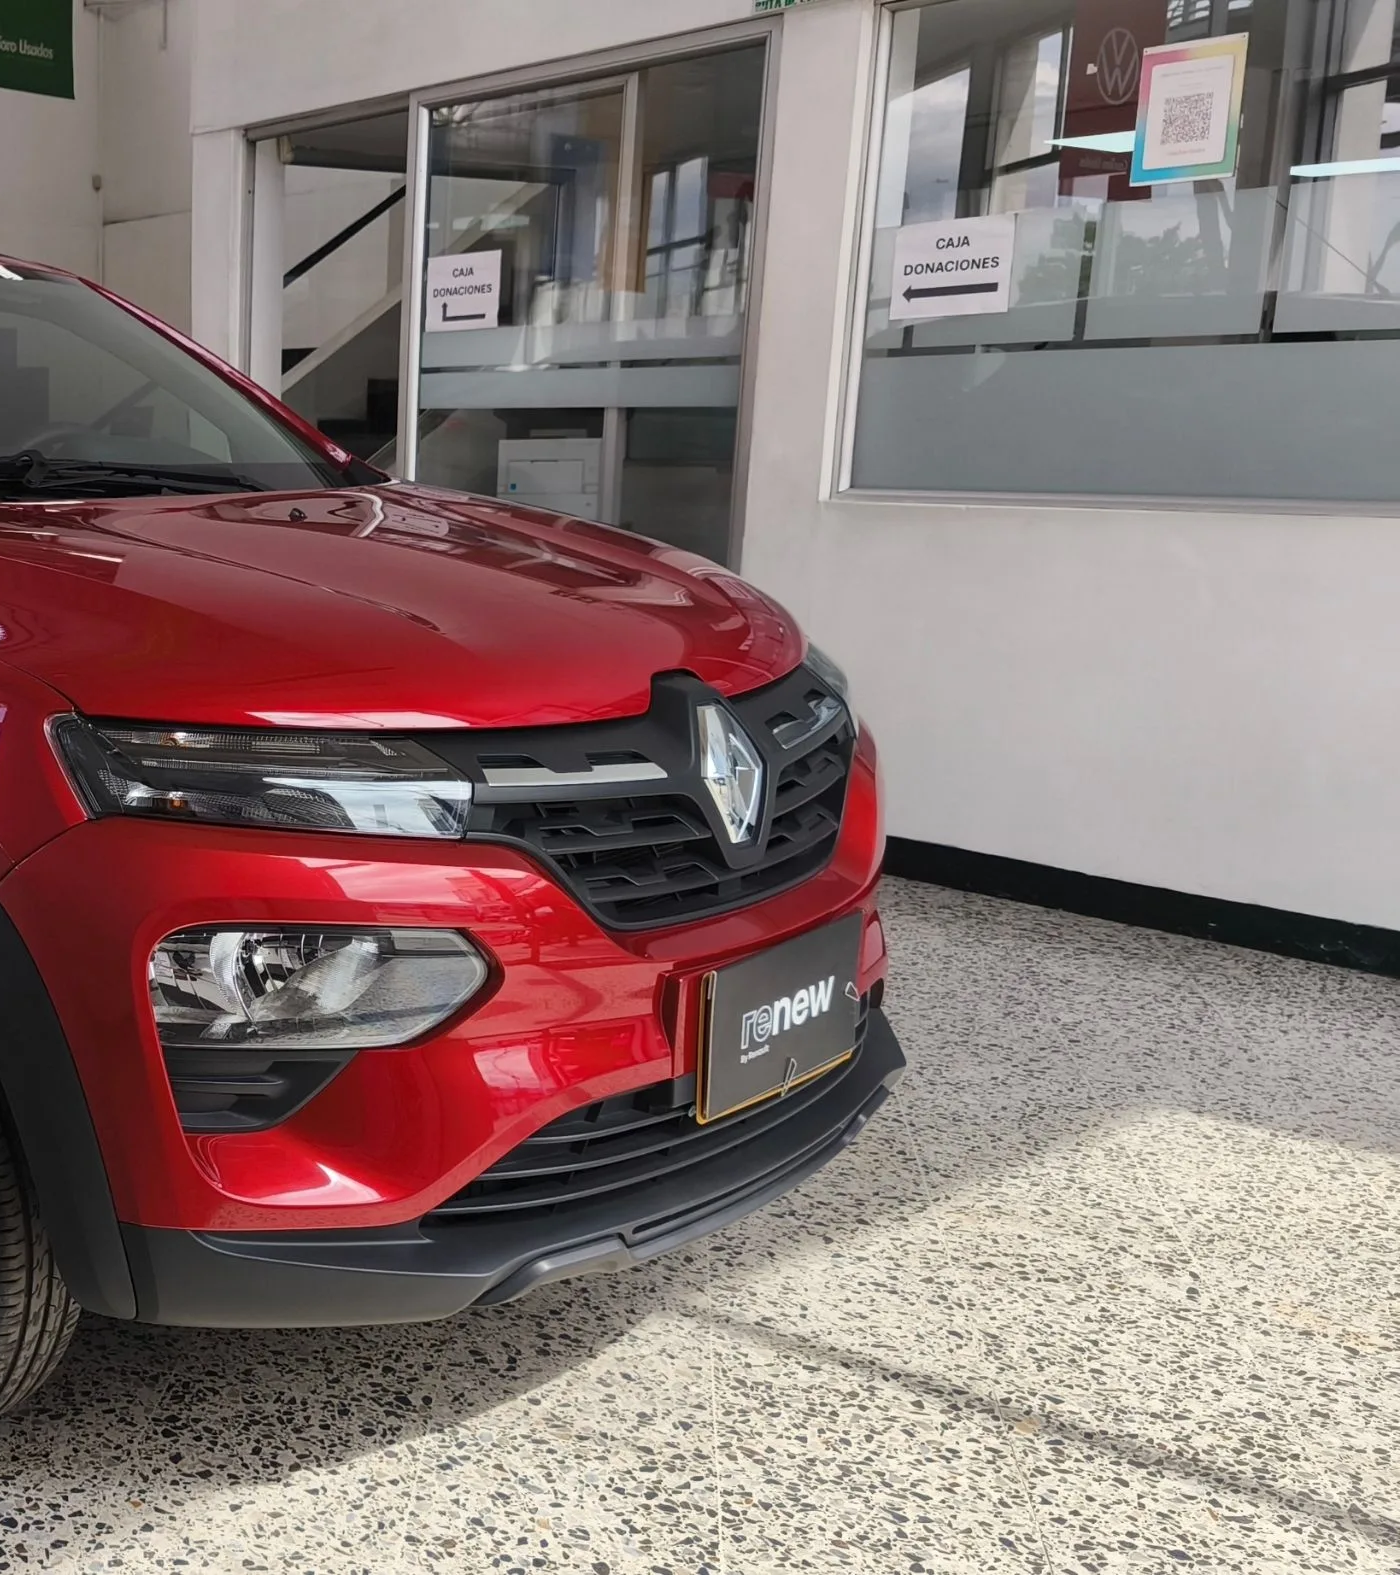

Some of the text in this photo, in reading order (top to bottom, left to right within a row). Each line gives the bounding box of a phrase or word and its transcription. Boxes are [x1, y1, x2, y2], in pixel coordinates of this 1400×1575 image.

[19, 39, 53, 60] Usados
[936, 236, 971, 250] CAJA
[452, 266, 474, 278] CAJA
[903, 256, 1000, 276] DONACIONES
[433, 283, 492, 298] DONACIONES
[740, 975, 836, 1050] renew
